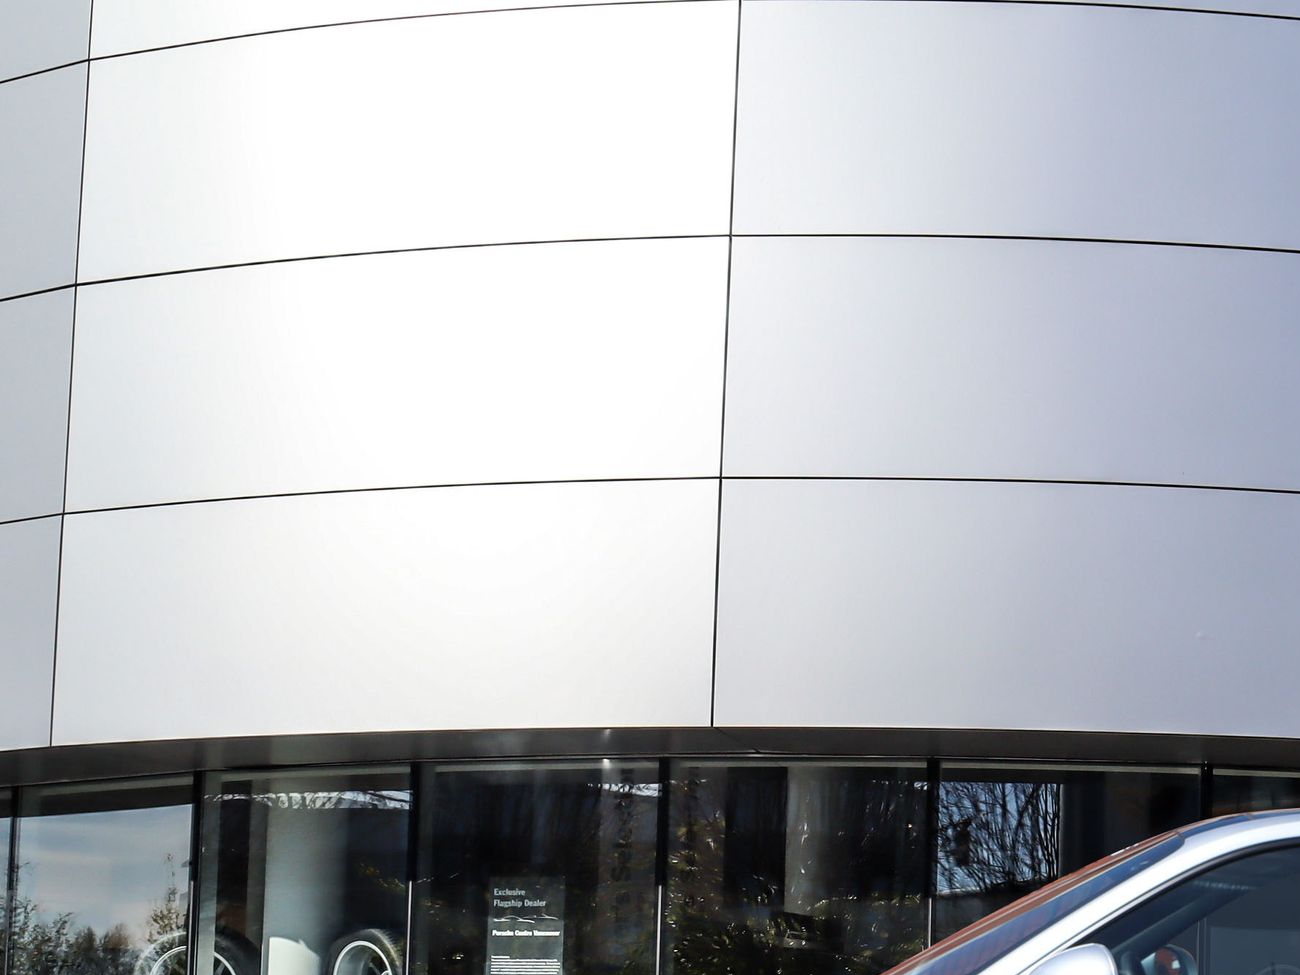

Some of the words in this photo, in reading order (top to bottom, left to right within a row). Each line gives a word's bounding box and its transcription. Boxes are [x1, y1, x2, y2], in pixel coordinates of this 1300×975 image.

[493, 888, 526, 896] Exclusive
[493, 899, 523, 908] Flagship
[524, 899, 547, 907] Dealer
